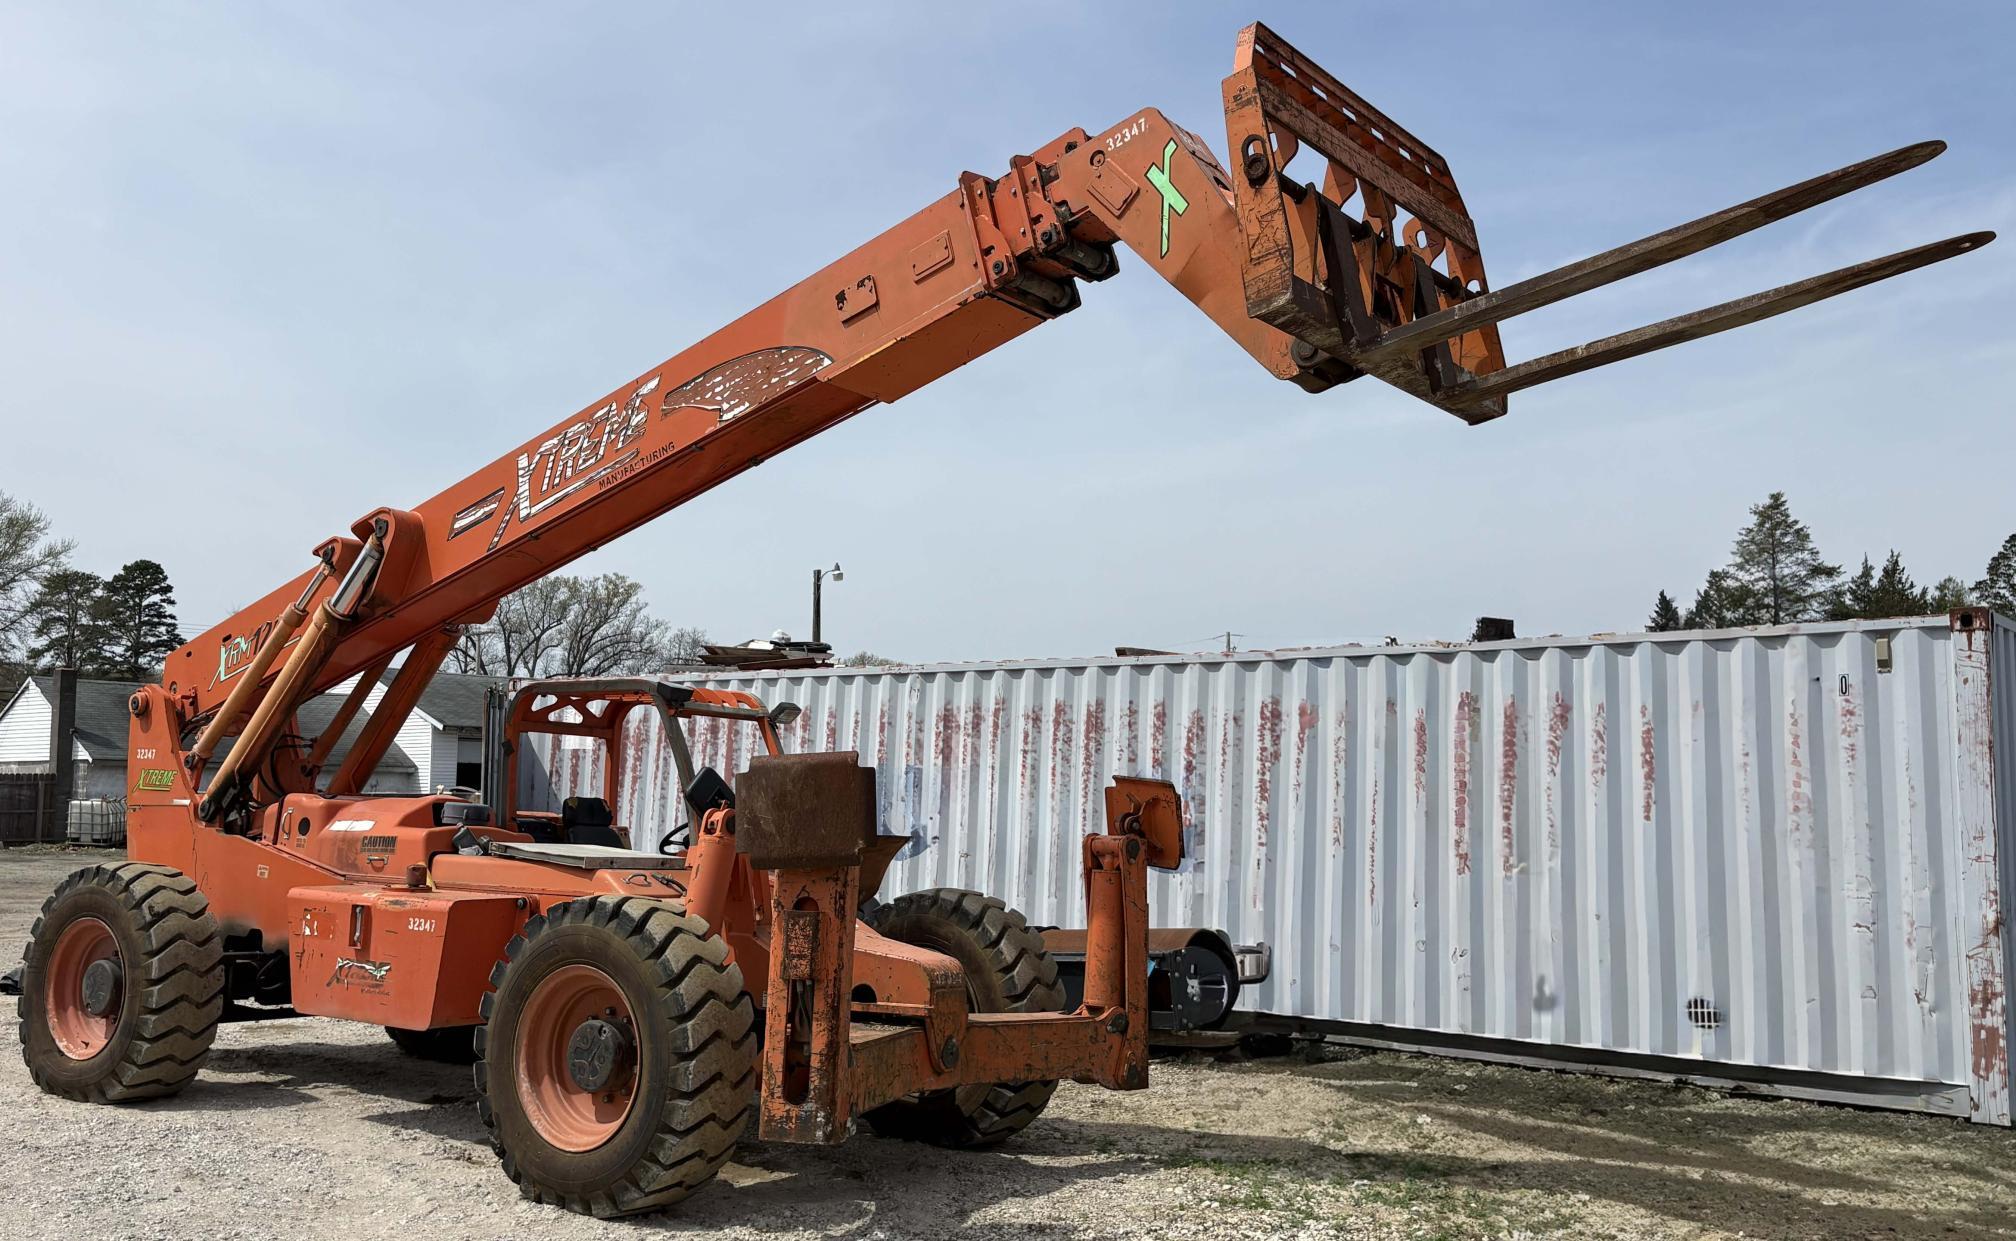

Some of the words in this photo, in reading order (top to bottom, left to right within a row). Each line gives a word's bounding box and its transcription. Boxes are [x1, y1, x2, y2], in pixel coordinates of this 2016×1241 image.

[1105, 118, 1146, 151] 32347
[598, 441, 675, 490] MANUFACTURING
[136, 748, 156, 760] 32347
[131, 768, 178, 793] XTREME
[362, 835, 398, 848] CAUTION
[408, 917, 436, 933] 32347
